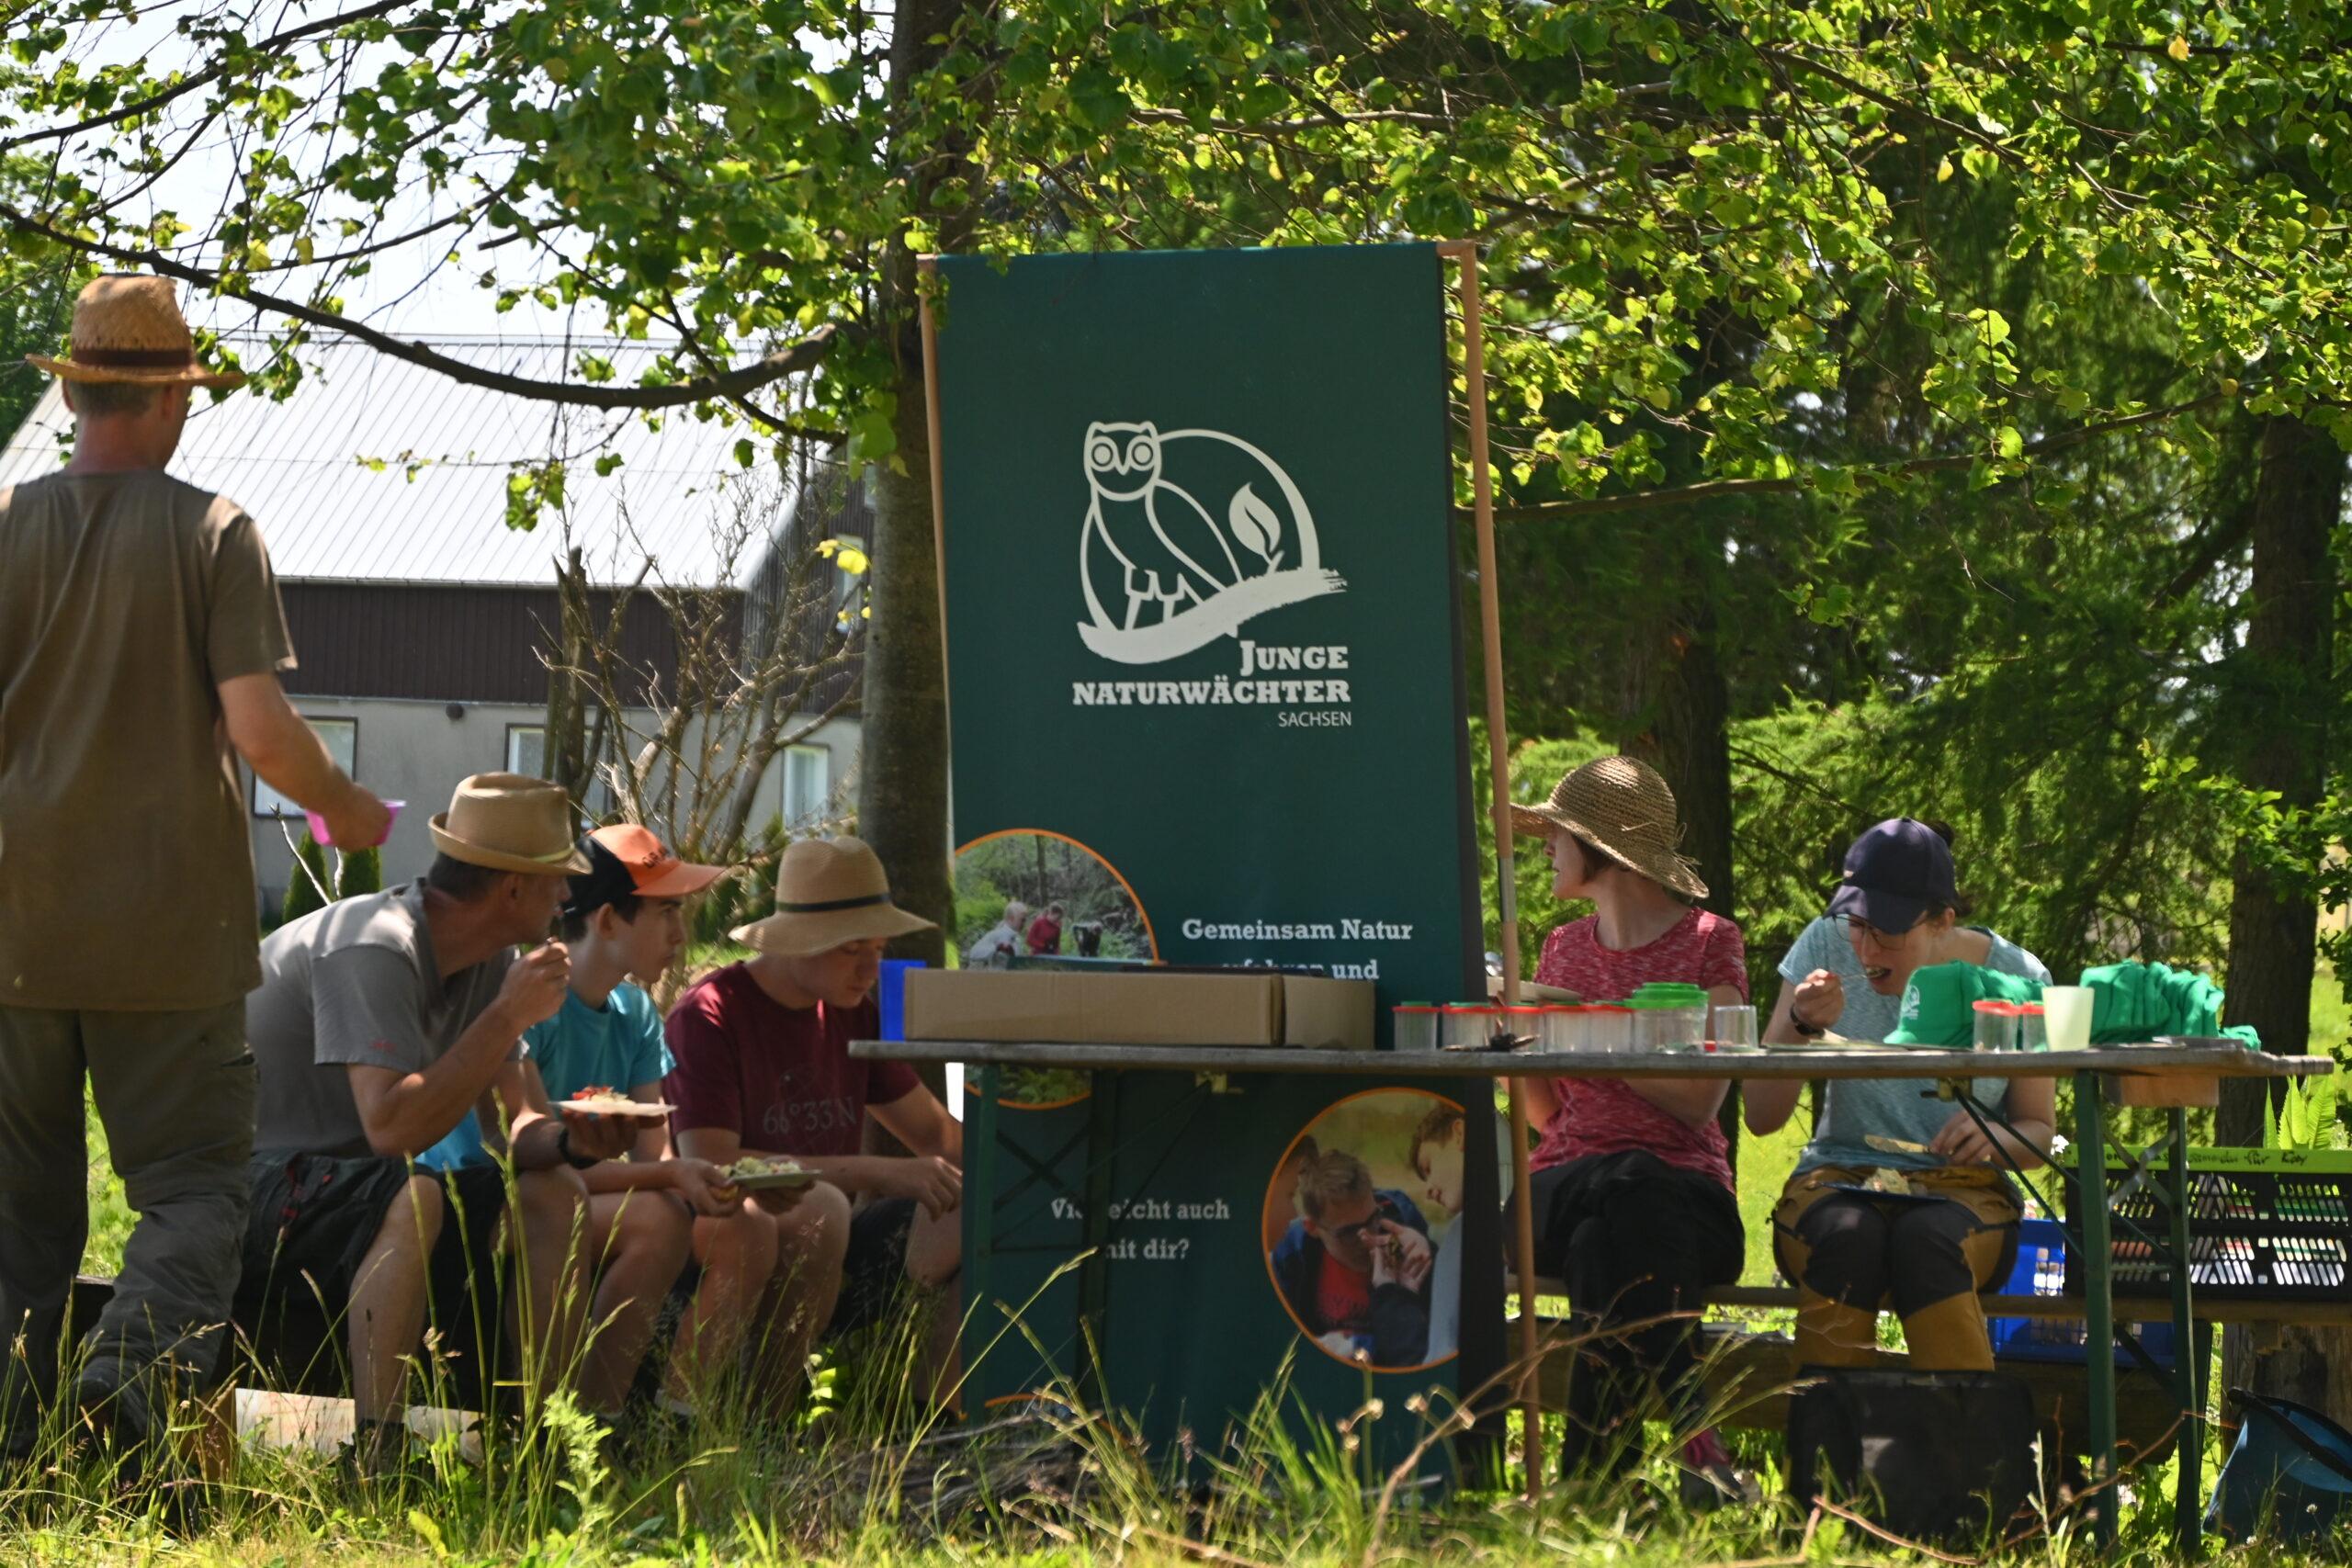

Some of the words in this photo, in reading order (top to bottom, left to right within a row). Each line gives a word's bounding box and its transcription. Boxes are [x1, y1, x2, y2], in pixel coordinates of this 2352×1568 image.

[1239, 640, 1349, 676] JUNGE
[1072, 674, 1351, 705] NATURWÄCHTER
[1278, 711, 1352, 728] SACHSEN
[1182, 919, 1335, 941] Gemeinsam
[1340, 919, 1414, 941] Natur
[1331, 959, 1380, 980] und
[1177, 1198, 1231, 1220] auch
[1143, 1238, 1191, 1260] dir?
